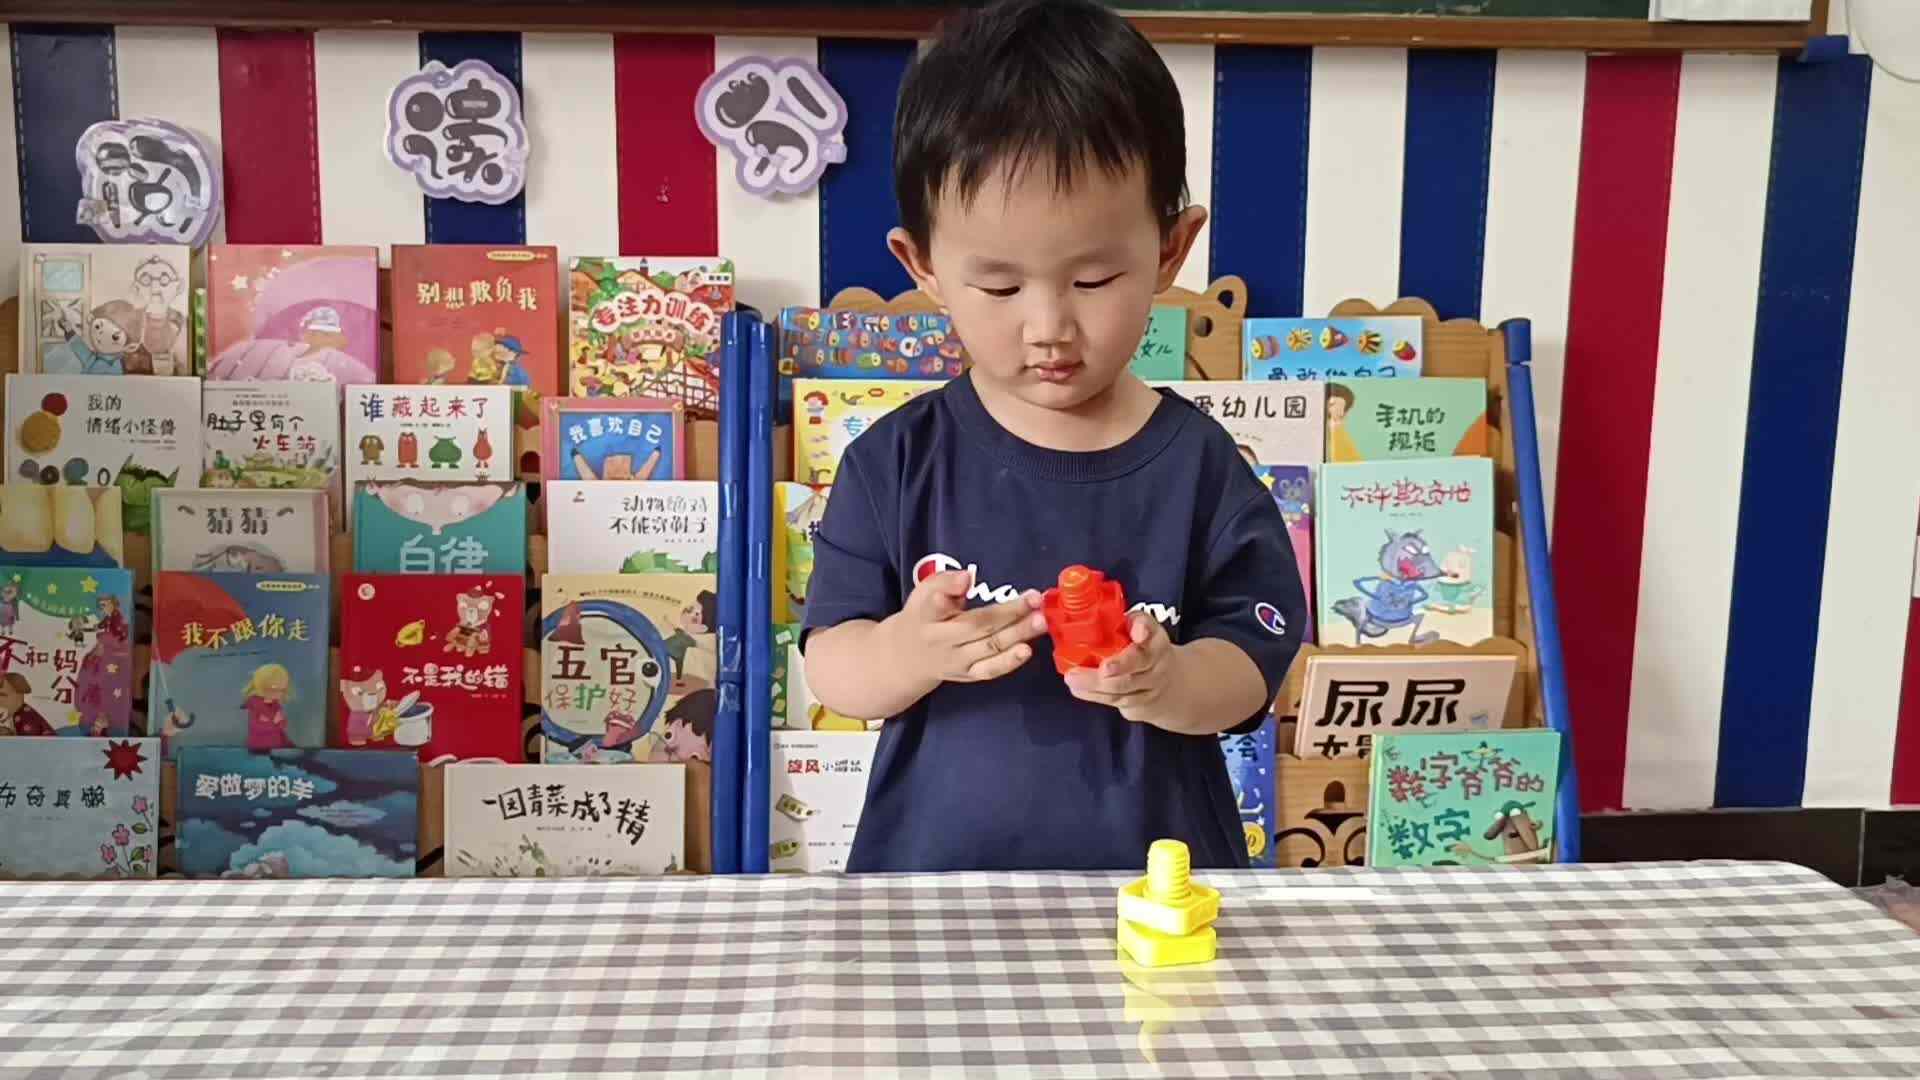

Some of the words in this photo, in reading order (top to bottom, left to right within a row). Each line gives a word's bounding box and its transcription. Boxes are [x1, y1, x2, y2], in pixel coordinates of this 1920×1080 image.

[416, 275, 538, 311] 别想欺负我
[595, 294, 711, 332] 专注力训练
[86, 394, 122, 411] 我的
[360, 393, 489, 423] 谁藏起来了
[1375, 403, 1446, 428] 手机的
[86, 416, 176, 436] 情绪小怪兽
[207, 409, 304, 432] 肚子里有个
[569, 415, 663, 444] 我喜欢自己
[252, 433, 316, 456] 火车站
[1388, 431, 1436, 453] 规矩
[206, 507, 270, 535] 猜猜
[180, 612, 310, 650] 我不跟你走
[401, 663, 509, 691] 不是我的错
[551, 643, 638, 686] 五官
[545, 682, 638, 711] 保护好
[1315, 678, 1466, 728] 尿尿
[195, 773, 315, 800] 爱做梦的羊
[1386, 751, 1545, 802] 数字爷爷的
[481, 783, 651, 846] 一园青菜成了精
[1387, 807, 1471, 860] 数字
